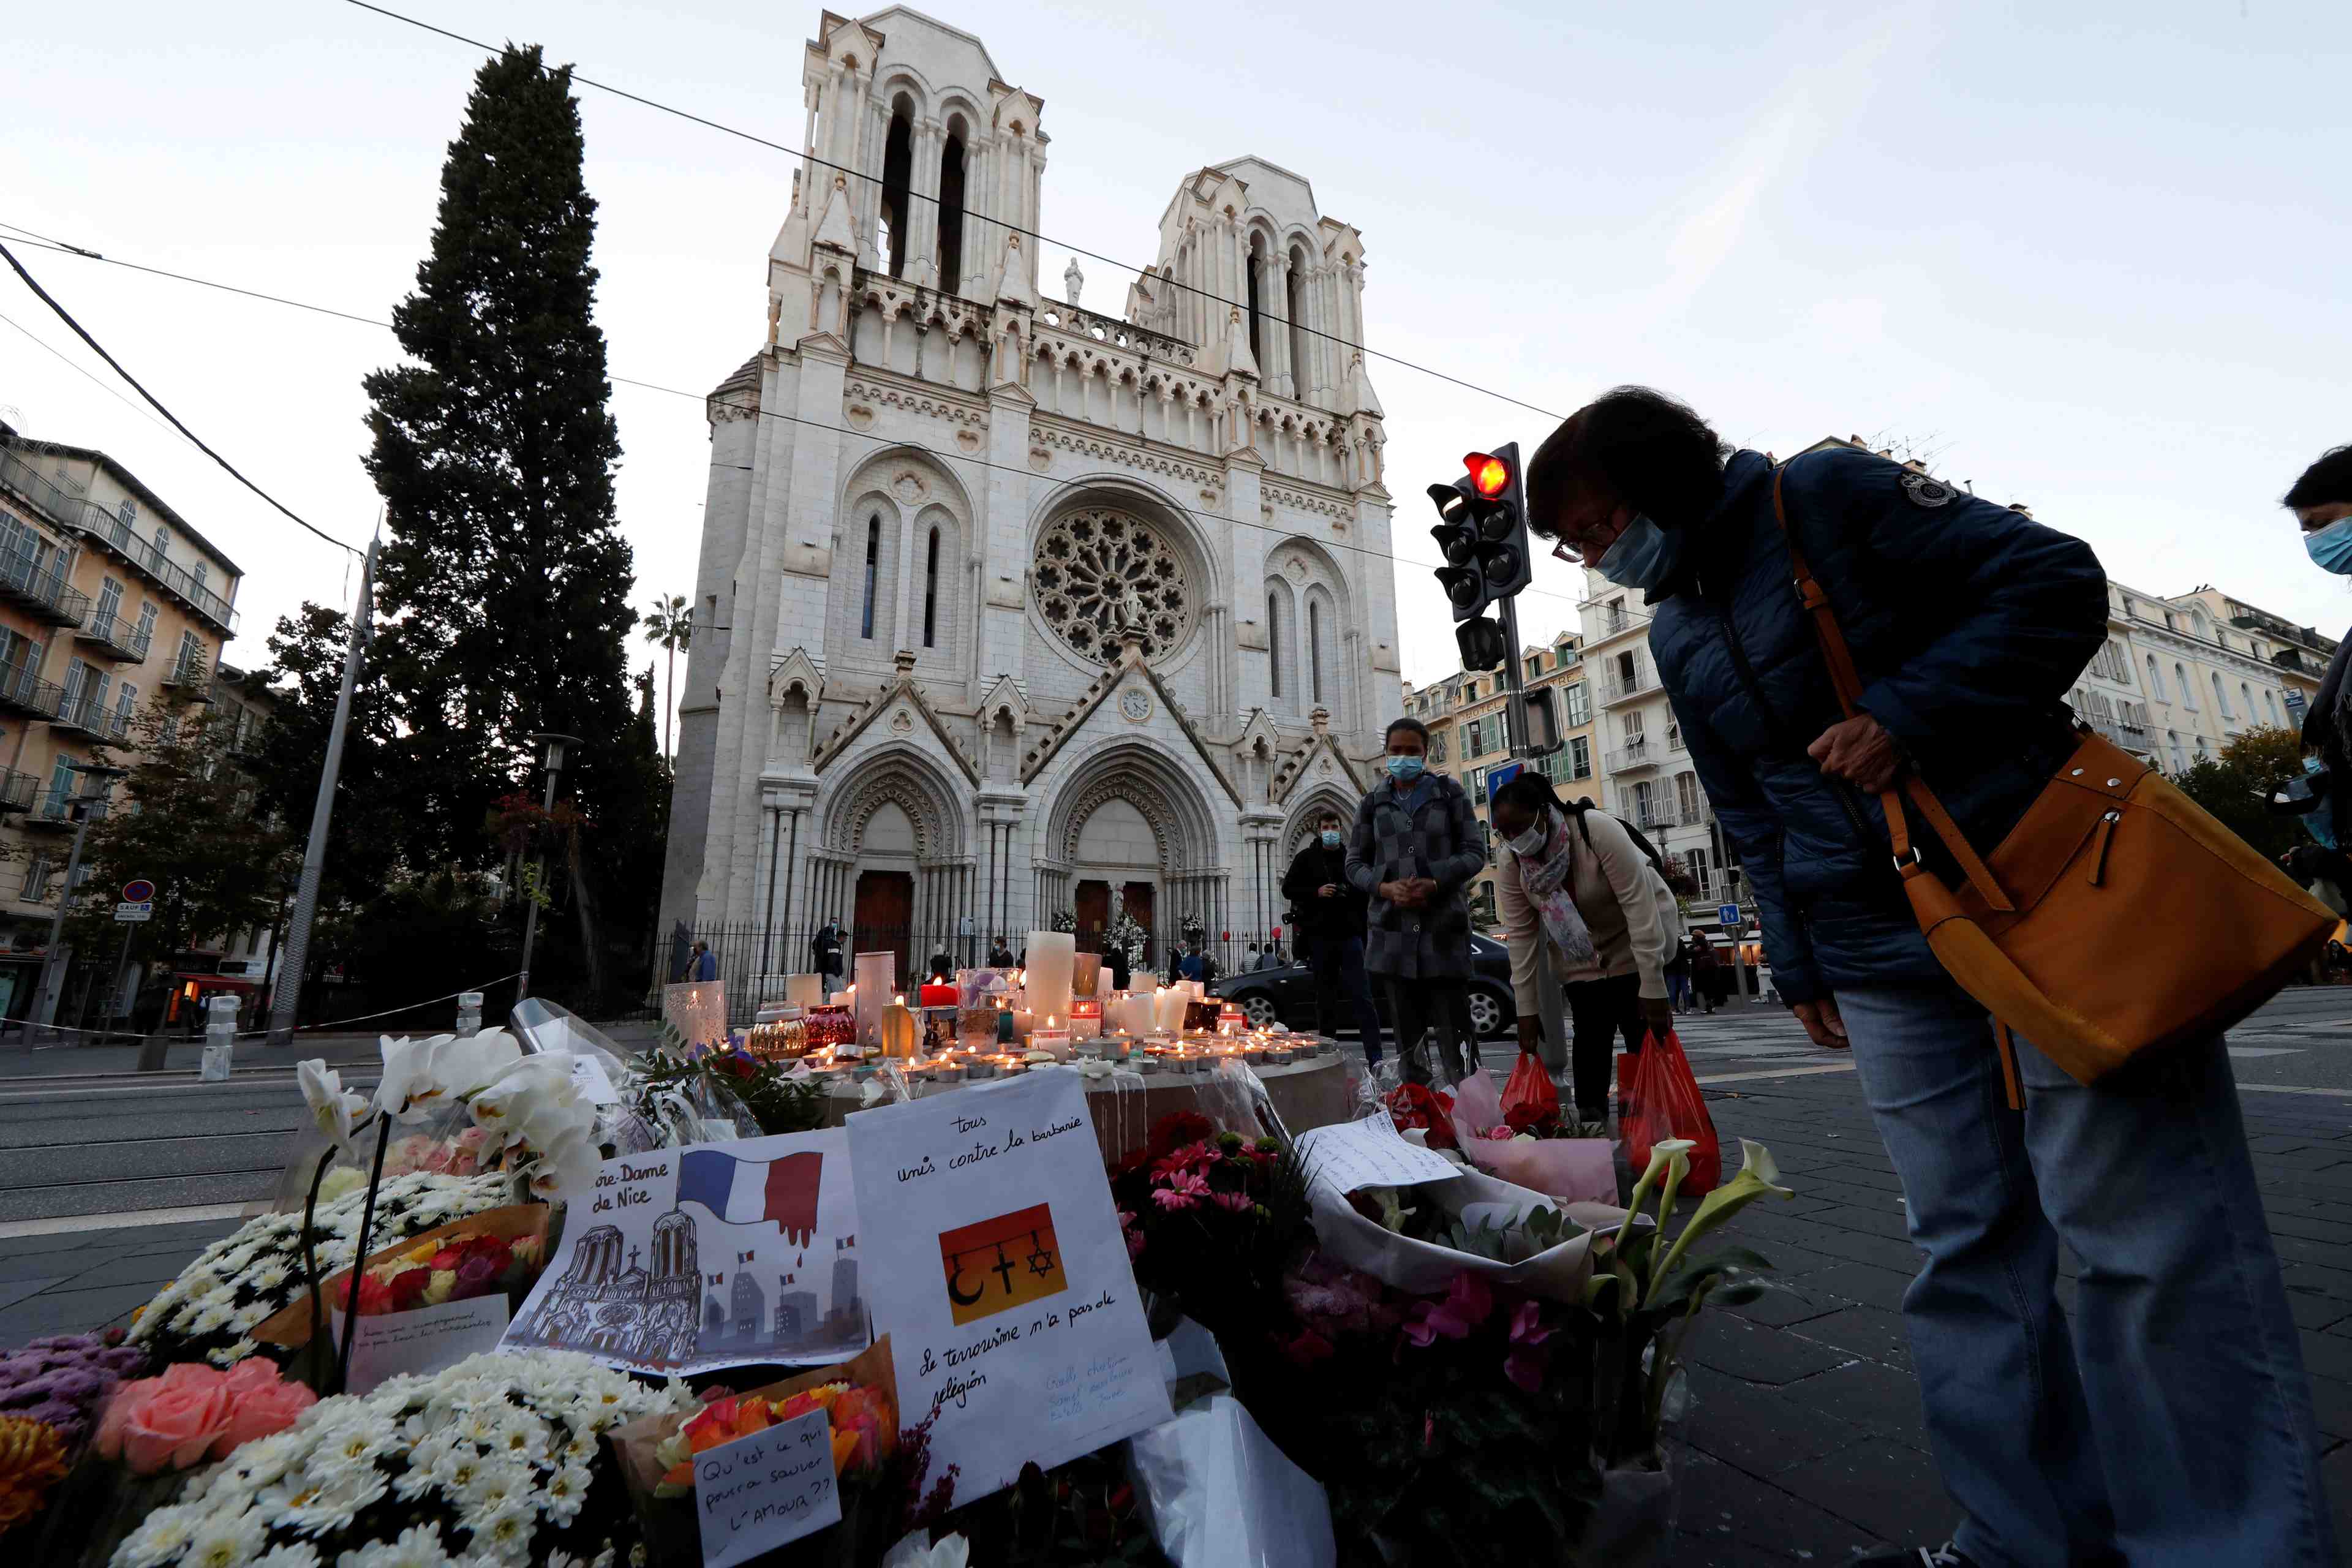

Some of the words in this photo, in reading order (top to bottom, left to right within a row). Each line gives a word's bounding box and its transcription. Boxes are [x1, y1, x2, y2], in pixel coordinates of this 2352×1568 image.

[1466, 702, 1501, 720] HOTEL
[951, 1115, 987, 1133] tous
[897, 1156, 935, 1182] unis
[949, 1142, 998, 1169] contre
[1003, 1129, 1025, 1153] la
[1031, 1117, 1083, 1142] barbarie
[593, 1193, 612, 1213] de
[617, 1187, 652, 1208] Nice
[1029, 1313, 1060, 1336] n'a
[1069, 1303, 1093, 1328] pas
[1096, 1290, 1116, 1308] de
[703, 1446, 764, 1481] Qu'est
[800, 1428, 822, 1448] qui
[706, 1479, 762, 1513] pourra
[770, 1457, 823, 1483] sauver
[731, 1495, 809, 1531] L'AMOUR
